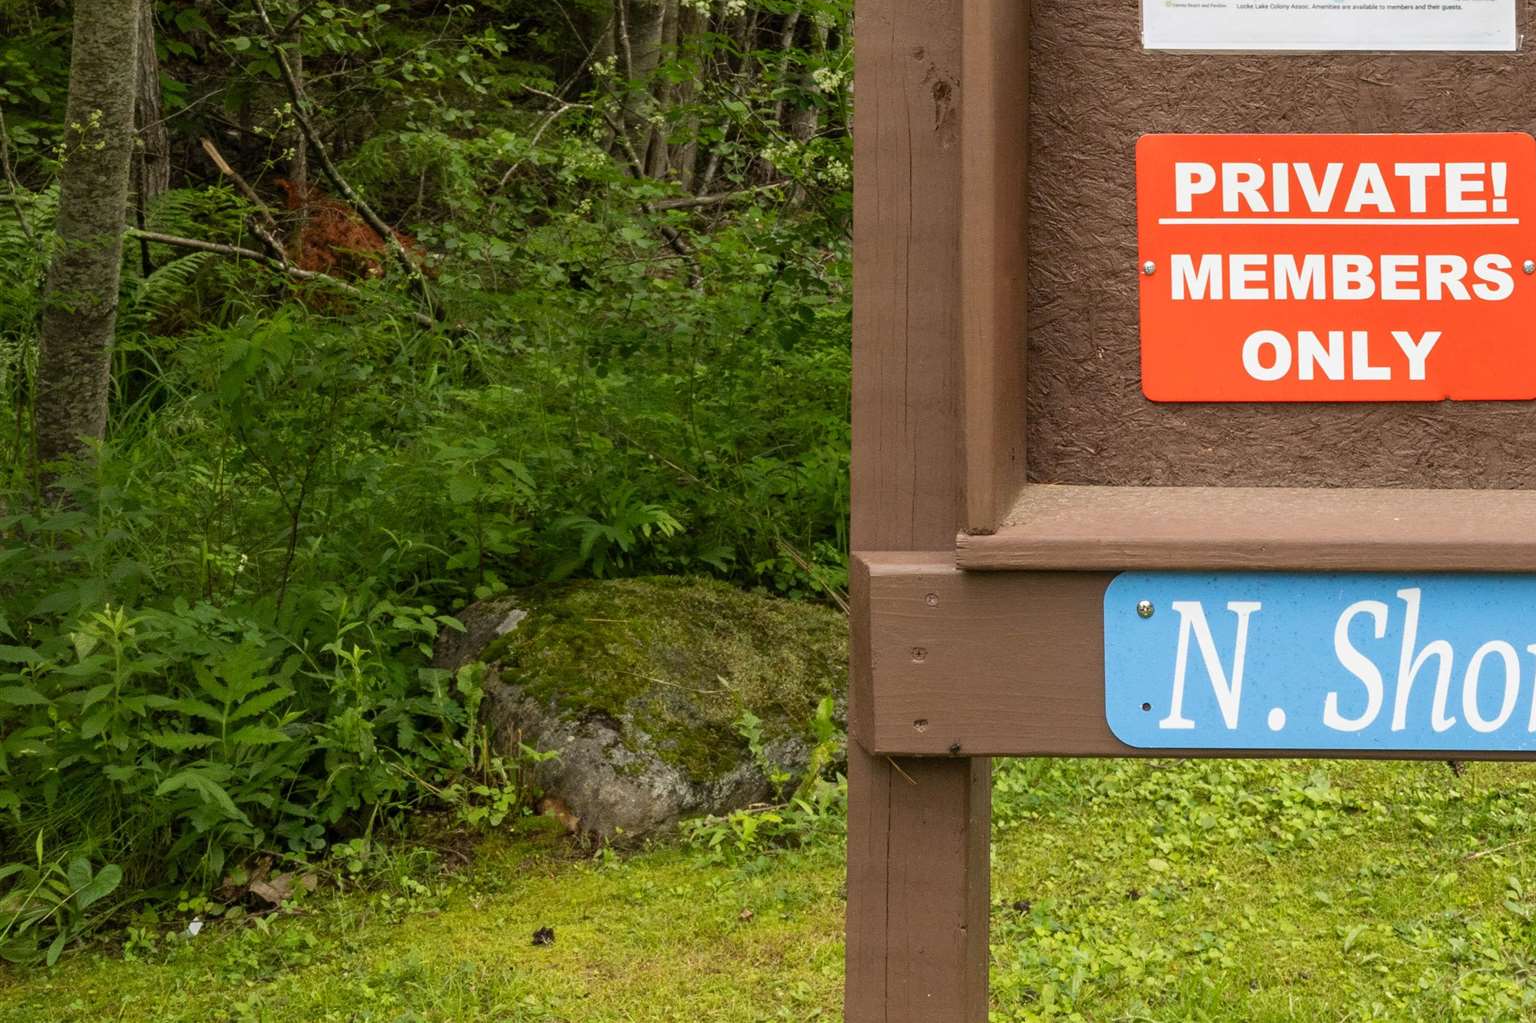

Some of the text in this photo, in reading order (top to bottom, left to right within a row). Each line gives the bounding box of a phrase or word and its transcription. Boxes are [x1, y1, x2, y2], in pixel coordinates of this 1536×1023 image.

[1270, 3, 1290, 11] Colony
[1442, 3, 1463, 11] guests.
[1176, 162, 1506, 212] PRIVATE!
[1172, 254, 1514, 300] MEMBERS
[1242, 330, 1442, 380] ONLY
[1159, 602, 1286, 731] N.
